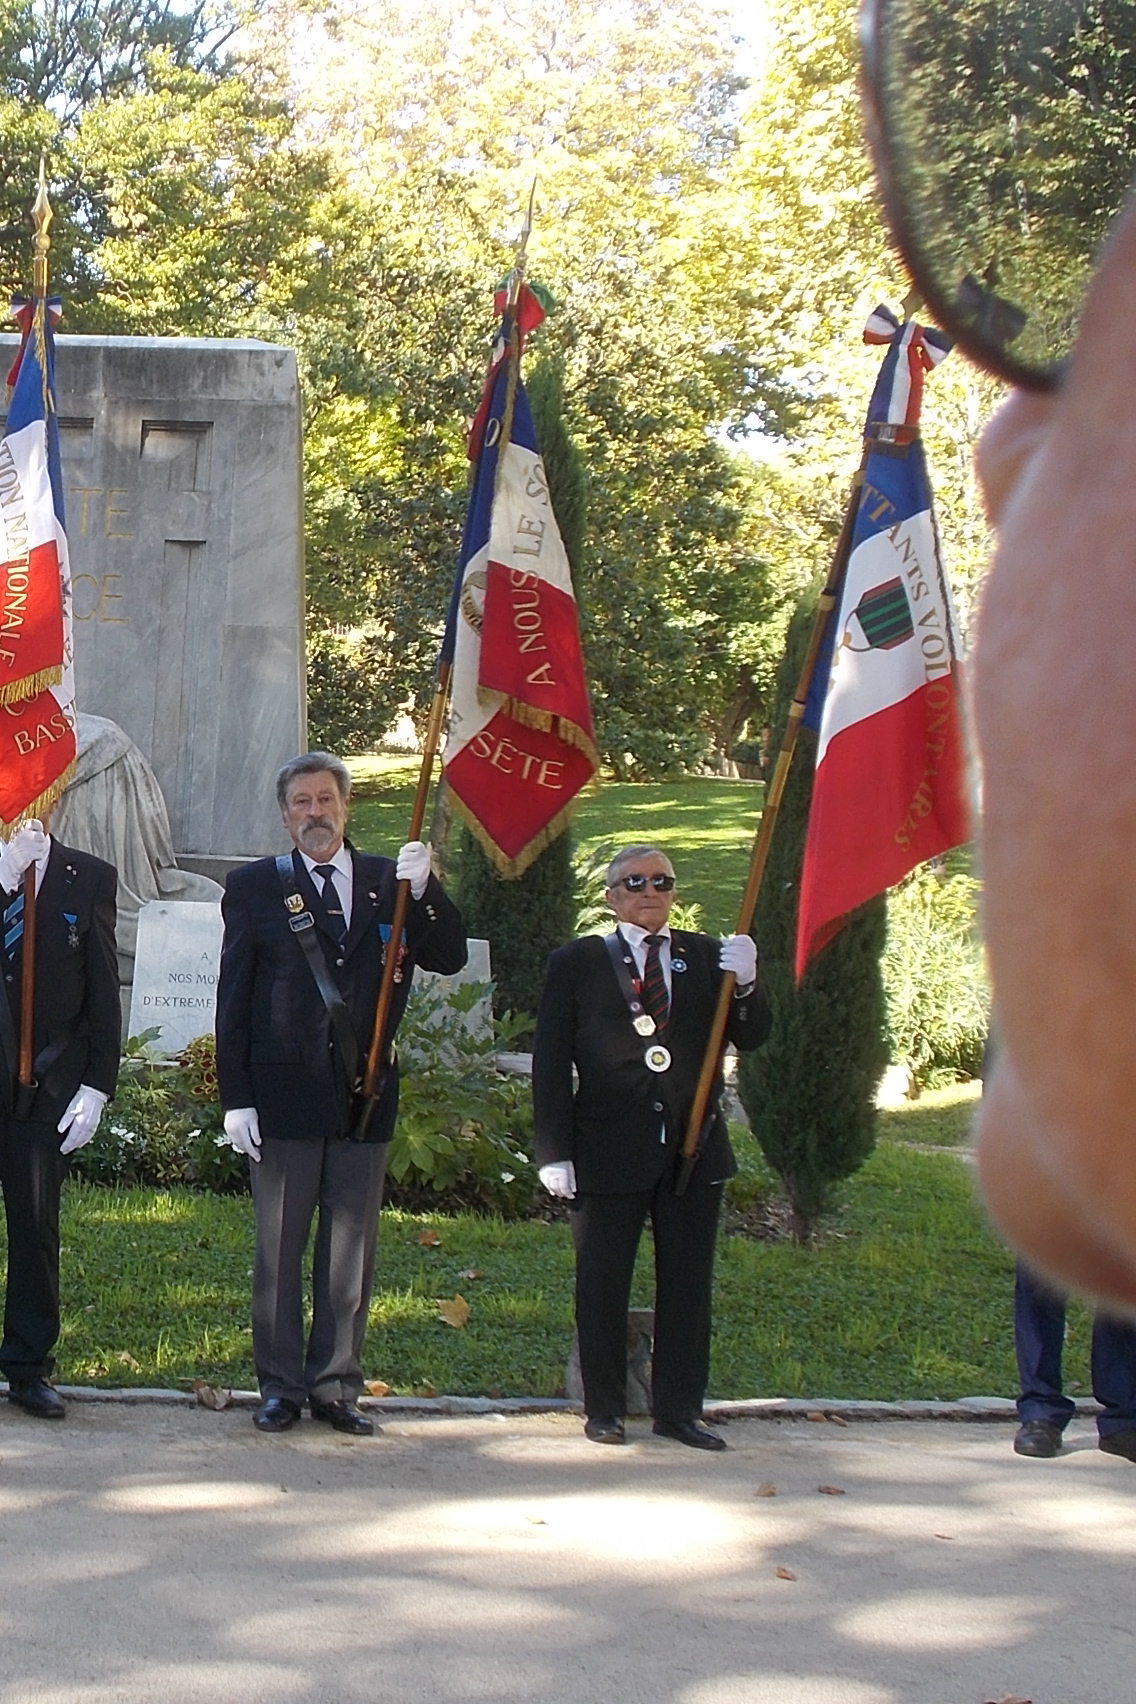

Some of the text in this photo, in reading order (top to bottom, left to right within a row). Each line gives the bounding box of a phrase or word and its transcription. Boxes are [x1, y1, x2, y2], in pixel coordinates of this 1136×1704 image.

[512, 513, 546, 558] LE
[510, 569, 548, 654] NOUS
[167, 973, 193, 984] NOS
